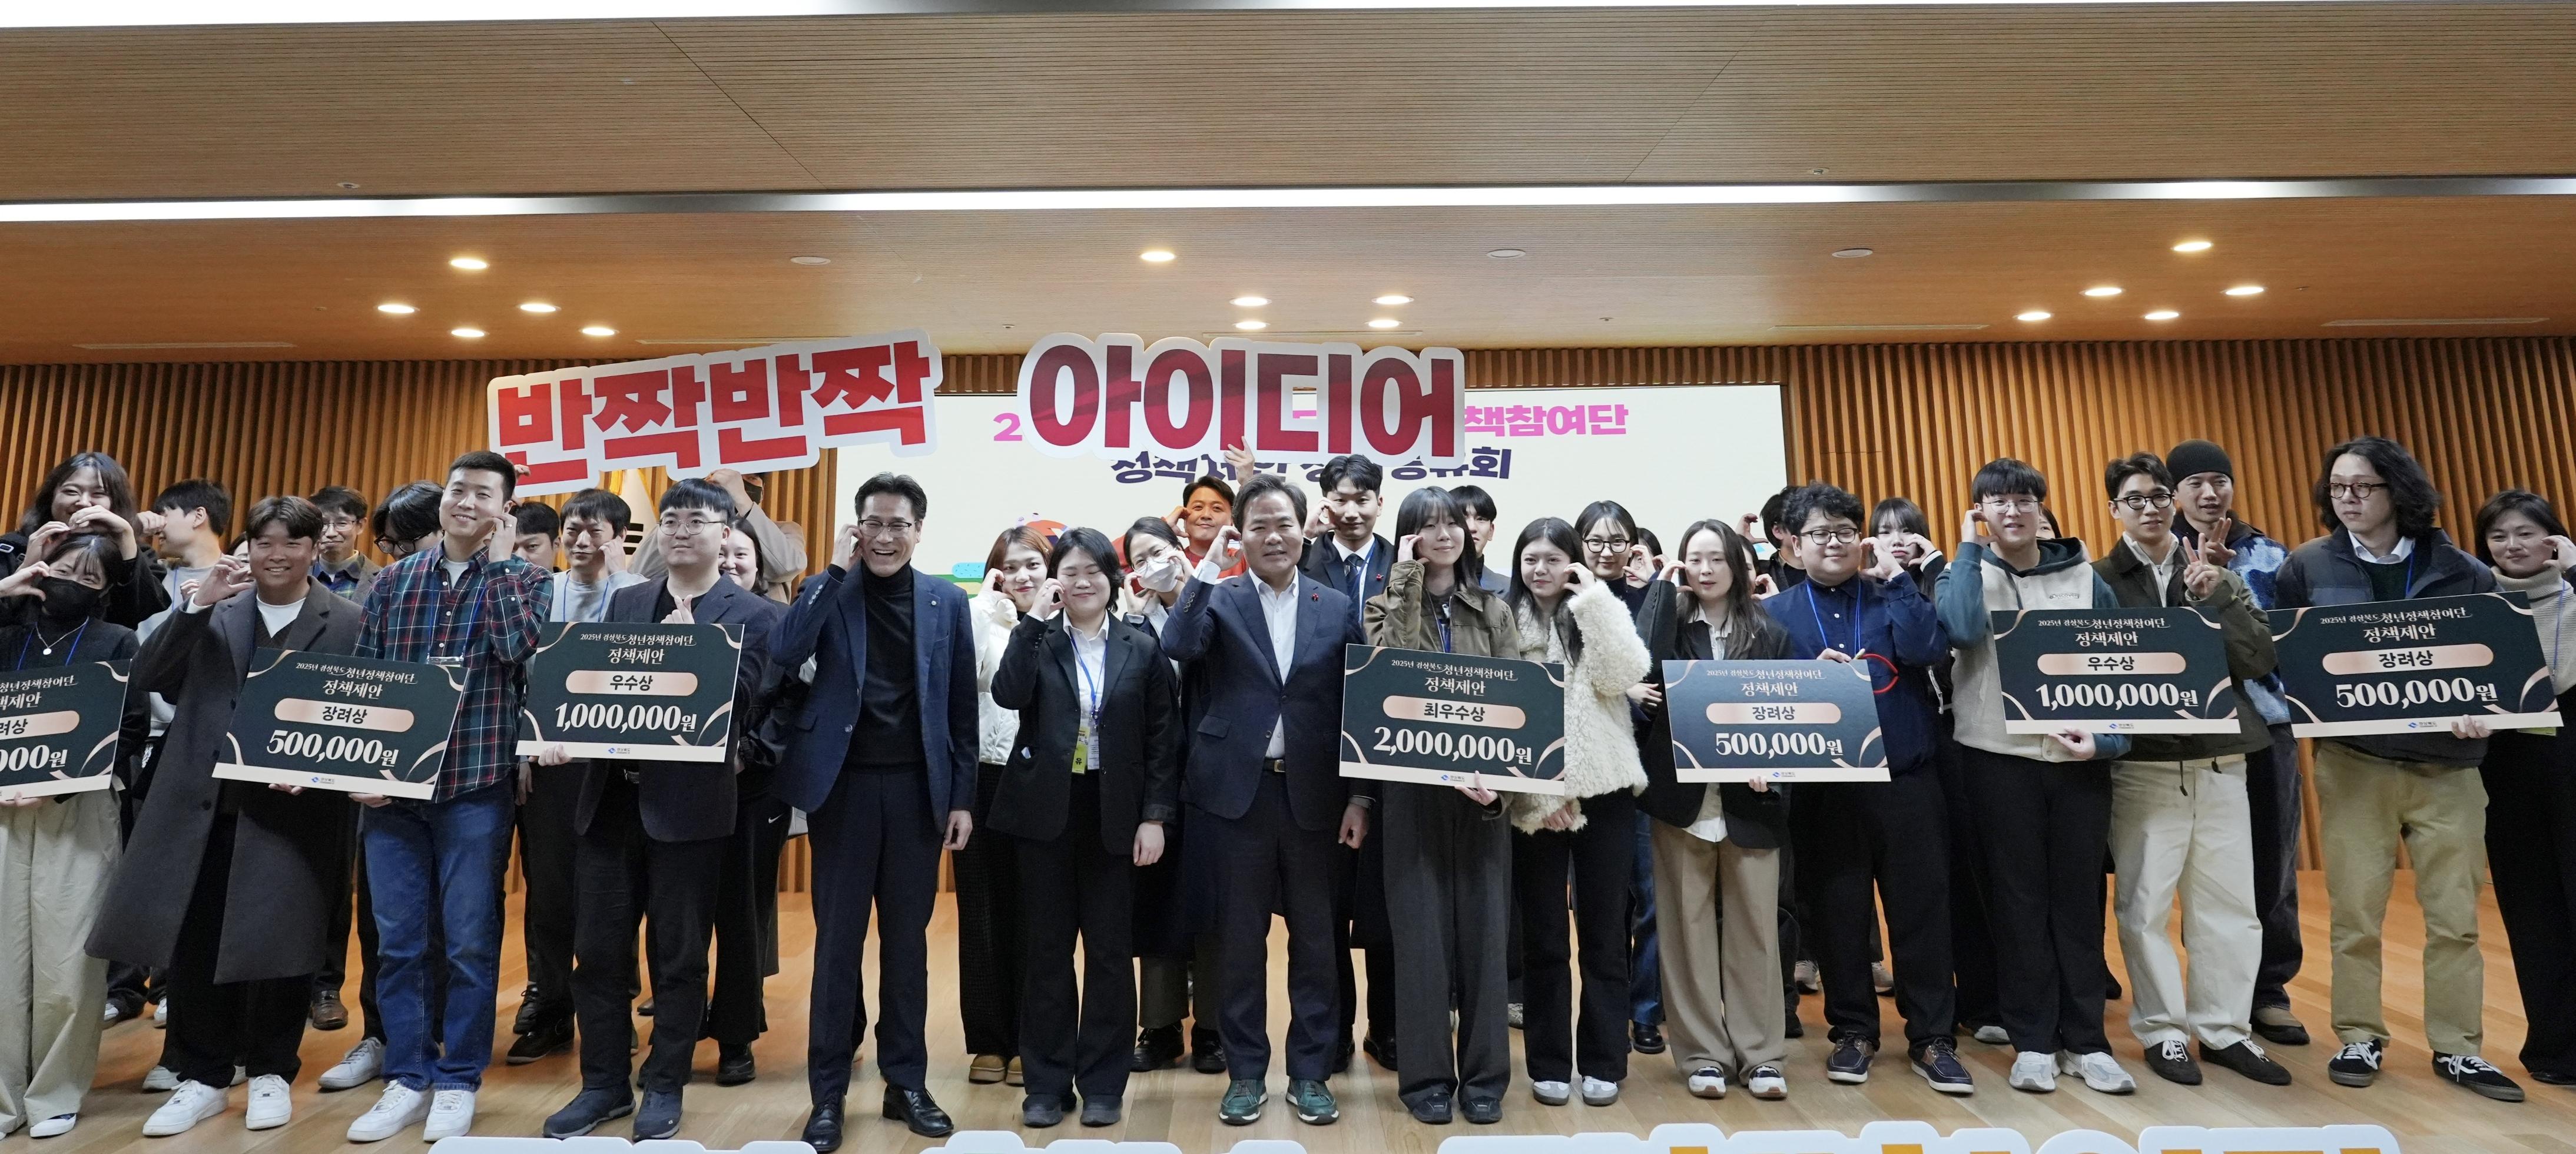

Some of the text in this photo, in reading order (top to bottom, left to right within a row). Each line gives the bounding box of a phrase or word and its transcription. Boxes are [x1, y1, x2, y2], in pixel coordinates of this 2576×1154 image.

[1030, 344, 1454, 462] 아이디어
[497, 340, 930, 486] 반짝반짝
[1464, 404, 1629, 437] 책참여단
[2063, 619, 2091, 628] 경상북도
[2091, 618, 2170, 629] 청년정책참여단
[2320, 607, 2472, 624] 2025년 경상북도 청년정책참여단
[603, 634, 629, 644] 경상북도
[628, 634, 697, 646] 청년정책참여단
[2076, 631, 2139, 646] 정책제안
[2363, 624, 2436, 643] 정책제안
[608, 648, 665, 665] 정책제안
[2087, 656, 2134, 671] 우수상
[2378, 650, 2434, 668] 장려상
[296, 662, 417, 685] 2025년 경상북도 청년정책참여단
[1391, 659, 1518, 681] 2025년 경상북도 청년정책참여단
[1730, 669, 1757, 678] 경상북도
[1756, 669, 1826, 679] 청년정책참여단
[323, 679, 383, 700] 정책제안
[610, 675, 654, 691] 우수상
[1424, 677, 1486, 697] 정책제안
[1741, 682, 1798, 697] 정책제안
[2035, 683, 2199, 711] 1,000,000원
[2336, 677, 2498, 709] 500,000원
[322, 706, 368, 725] 장려상
[555, 702, 697, 734] 1,000,000원
[1424, 702, 1486, 722] 최우수상
[1752, 707, 1796, 721] 장려상
[0, 718, 28, 736] 려상
[266, 729, 399, 767] 500,000원
[1373, 726, 1531, 765] 2,000,000원
[1716, 732, 1844, 760] 500,000원
